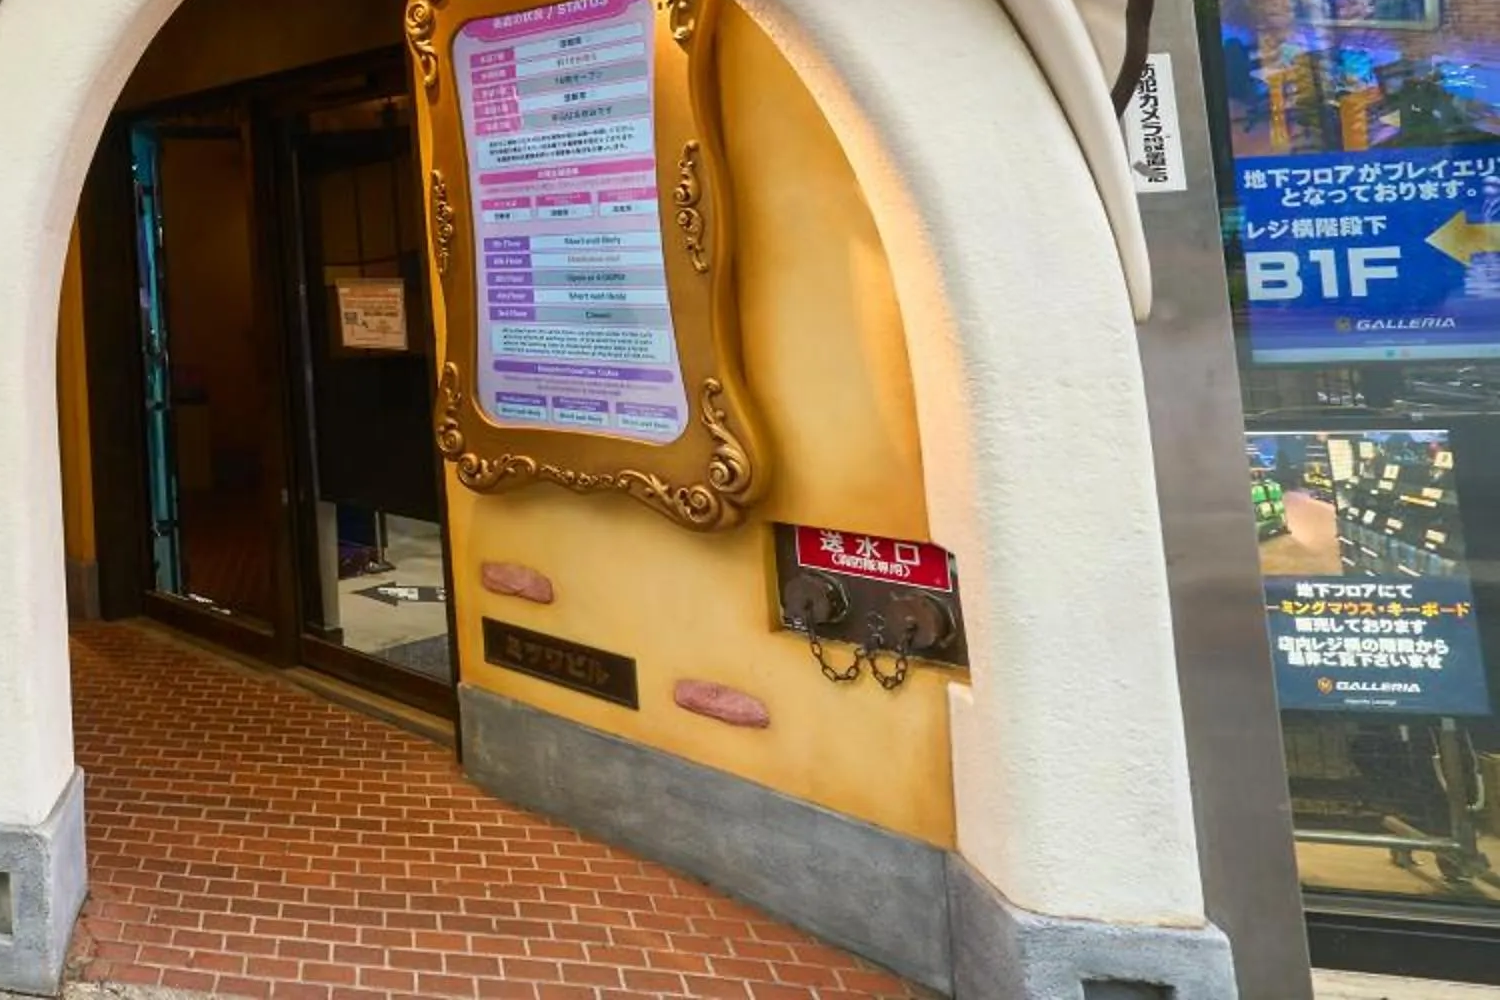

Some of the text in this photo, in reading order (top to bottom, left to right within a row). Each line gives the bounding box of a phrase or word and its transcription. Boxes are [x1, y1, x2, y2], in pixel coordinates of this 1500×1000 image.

[1243, 156, 1500, 189] 地下フロアがプレイエリ
[1281, 180, 1477, 207] となっております。
[1245, 246, 1402, 301] B1F
[1355, 317, 1457, 331] GALLERIA
[820, 530, 921, 566] 送水口
[1336, 681, 1421, 693] GALLERIA
